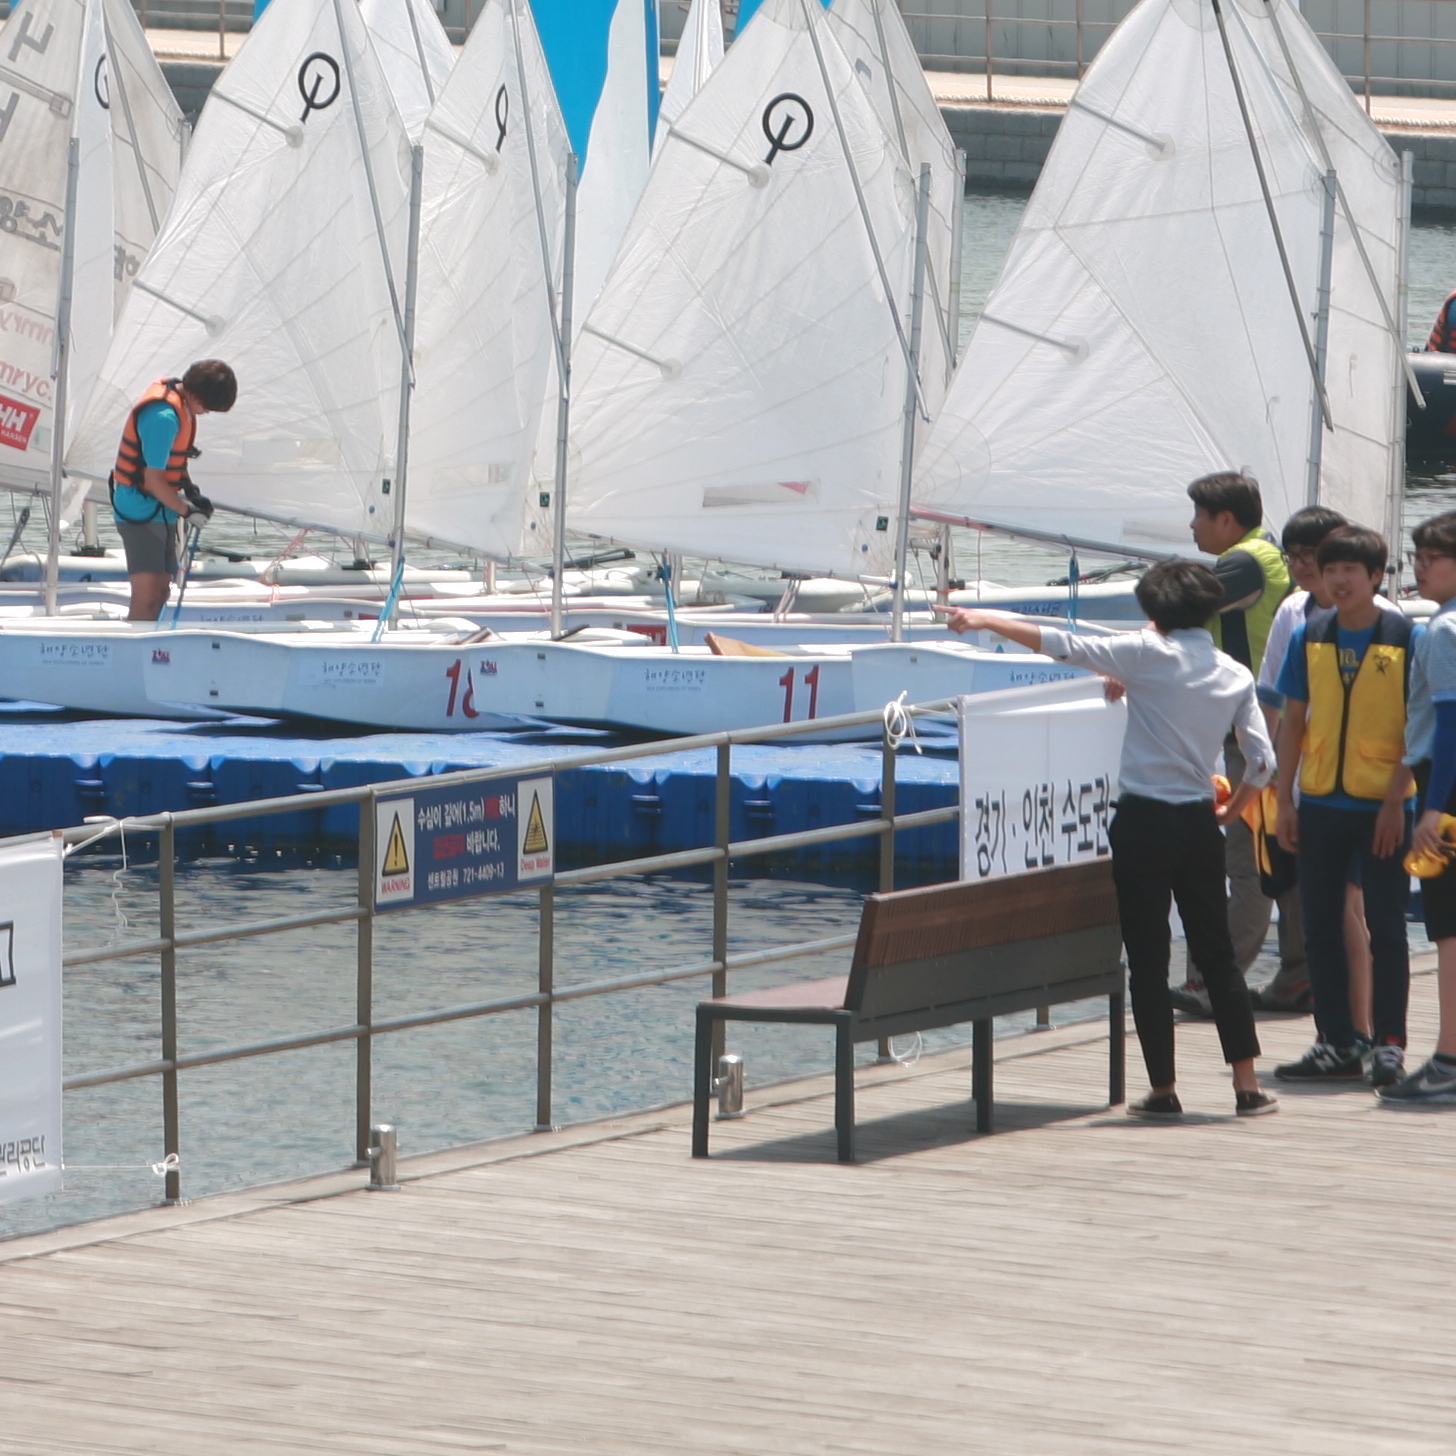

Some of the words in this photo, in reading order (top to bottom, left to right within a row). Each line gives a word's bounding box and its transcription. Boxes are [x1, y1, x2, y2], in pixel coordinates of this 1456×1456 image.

[779, 664, 820, 724] 11
[418, 805, 442, 831] 수심이
[1061, 772, 1110, 862] 수도권
